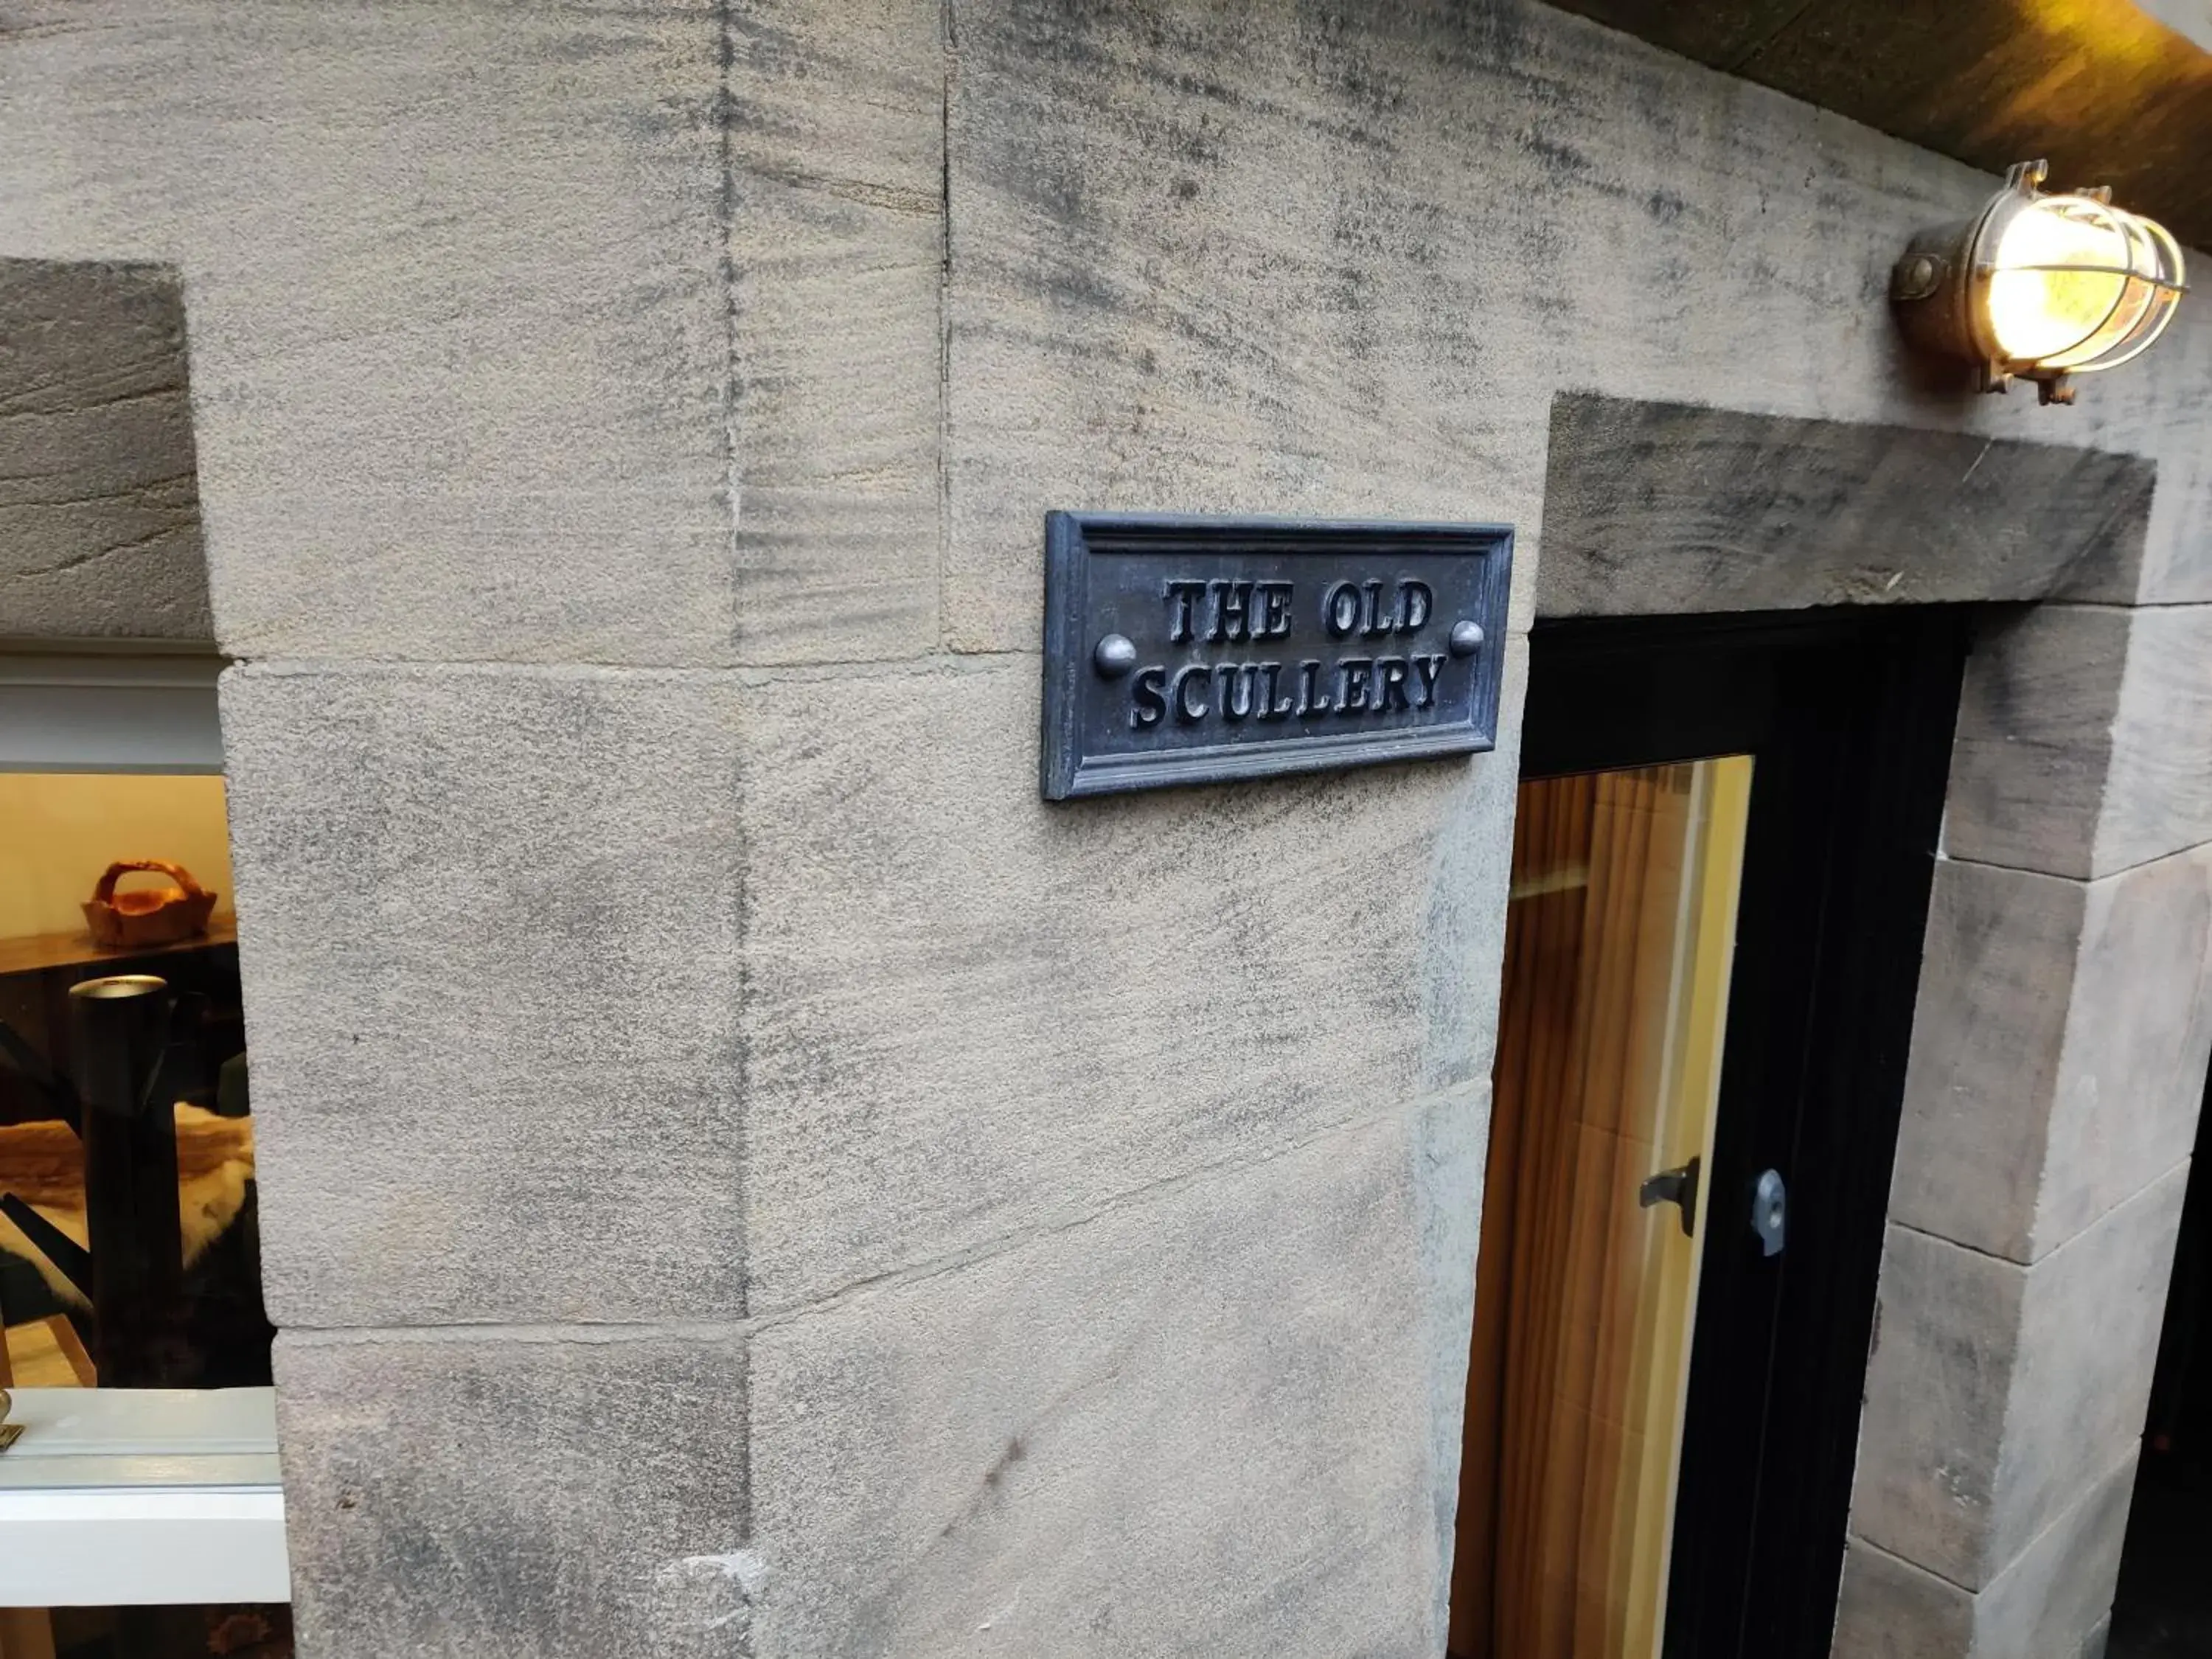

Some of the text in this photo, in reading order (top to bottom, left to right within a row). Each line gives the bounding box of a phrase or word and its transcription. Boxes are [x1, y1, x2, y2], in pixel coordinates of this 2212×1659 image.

[1162, 578, 1433, 642] THE OLD
[1130, 654, 1447, 728] SCULLERY
